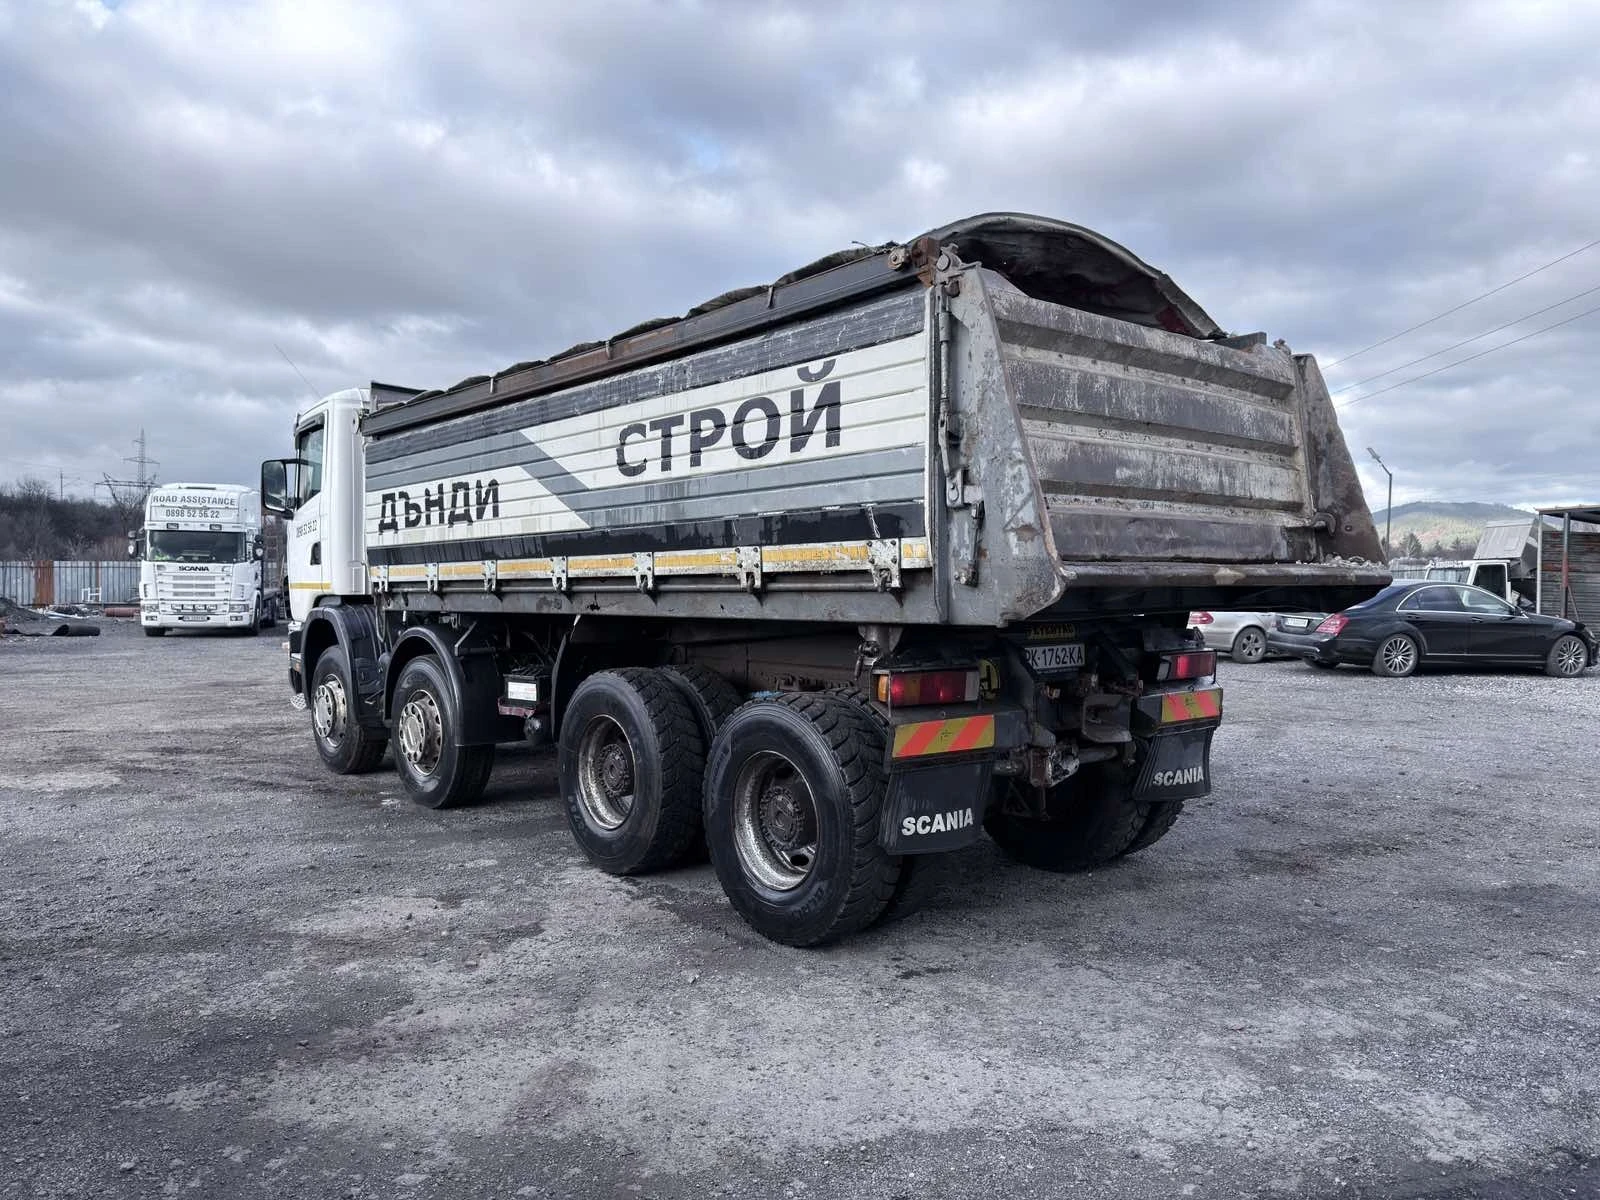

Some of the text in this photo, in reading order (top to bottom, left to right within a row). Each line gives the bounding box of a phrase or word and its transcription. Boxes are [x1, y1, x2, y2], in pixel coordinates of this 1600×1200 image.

[378, 359, 841, 534] ДЪНДИ СТРОЙ
[153, 495, 237, 506] ROAD ASSISTANCE
[165, 509, 185, 518] 0898
[187, 509, 197, 518] 52
[210, 511, 220, 519] 22
[1153, 767, 1205, 787] SCANIA
[901, 807, 974, 836] SCANIA
